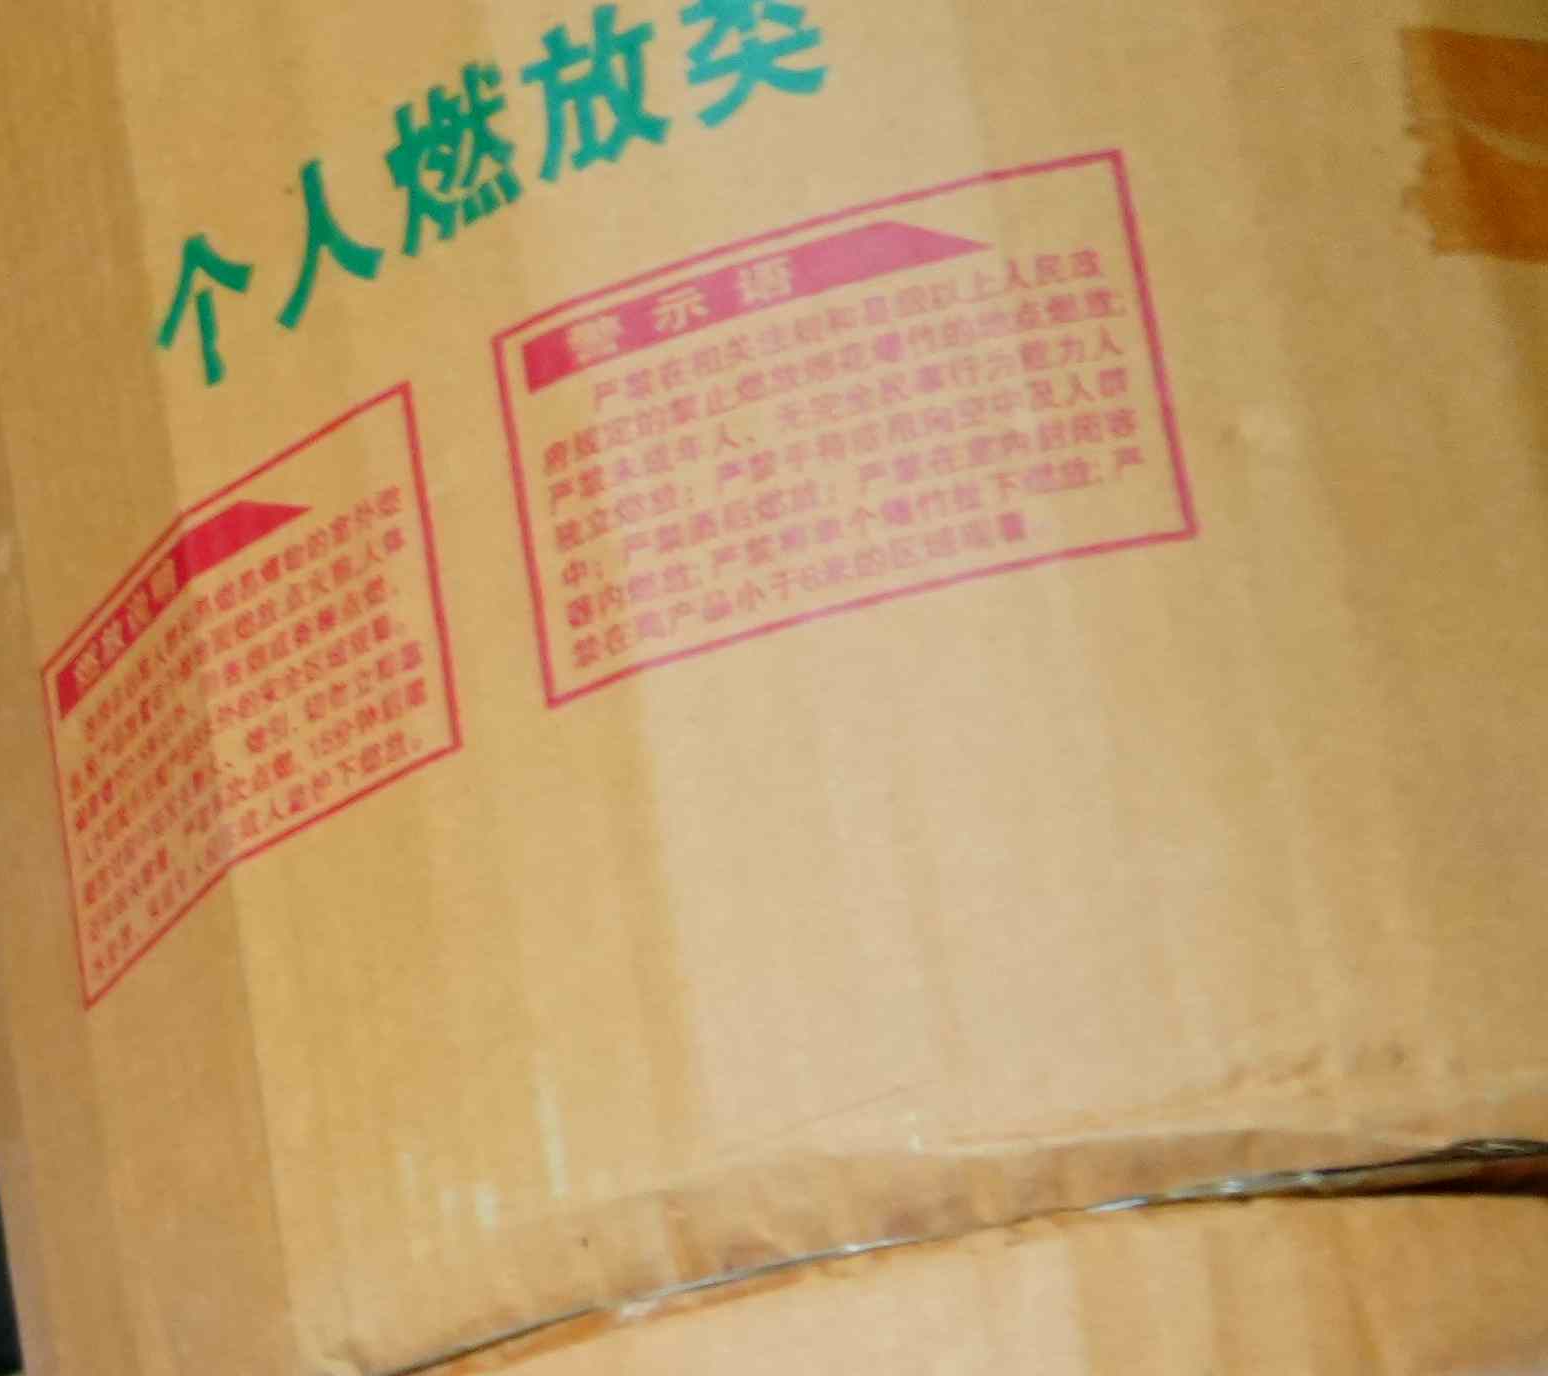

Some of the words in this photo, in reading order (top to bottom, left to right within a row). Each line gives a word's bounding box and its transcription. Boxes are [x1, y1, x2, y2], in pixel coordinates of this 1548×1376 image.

[156, 0, 828, 388] 个人燃放类
